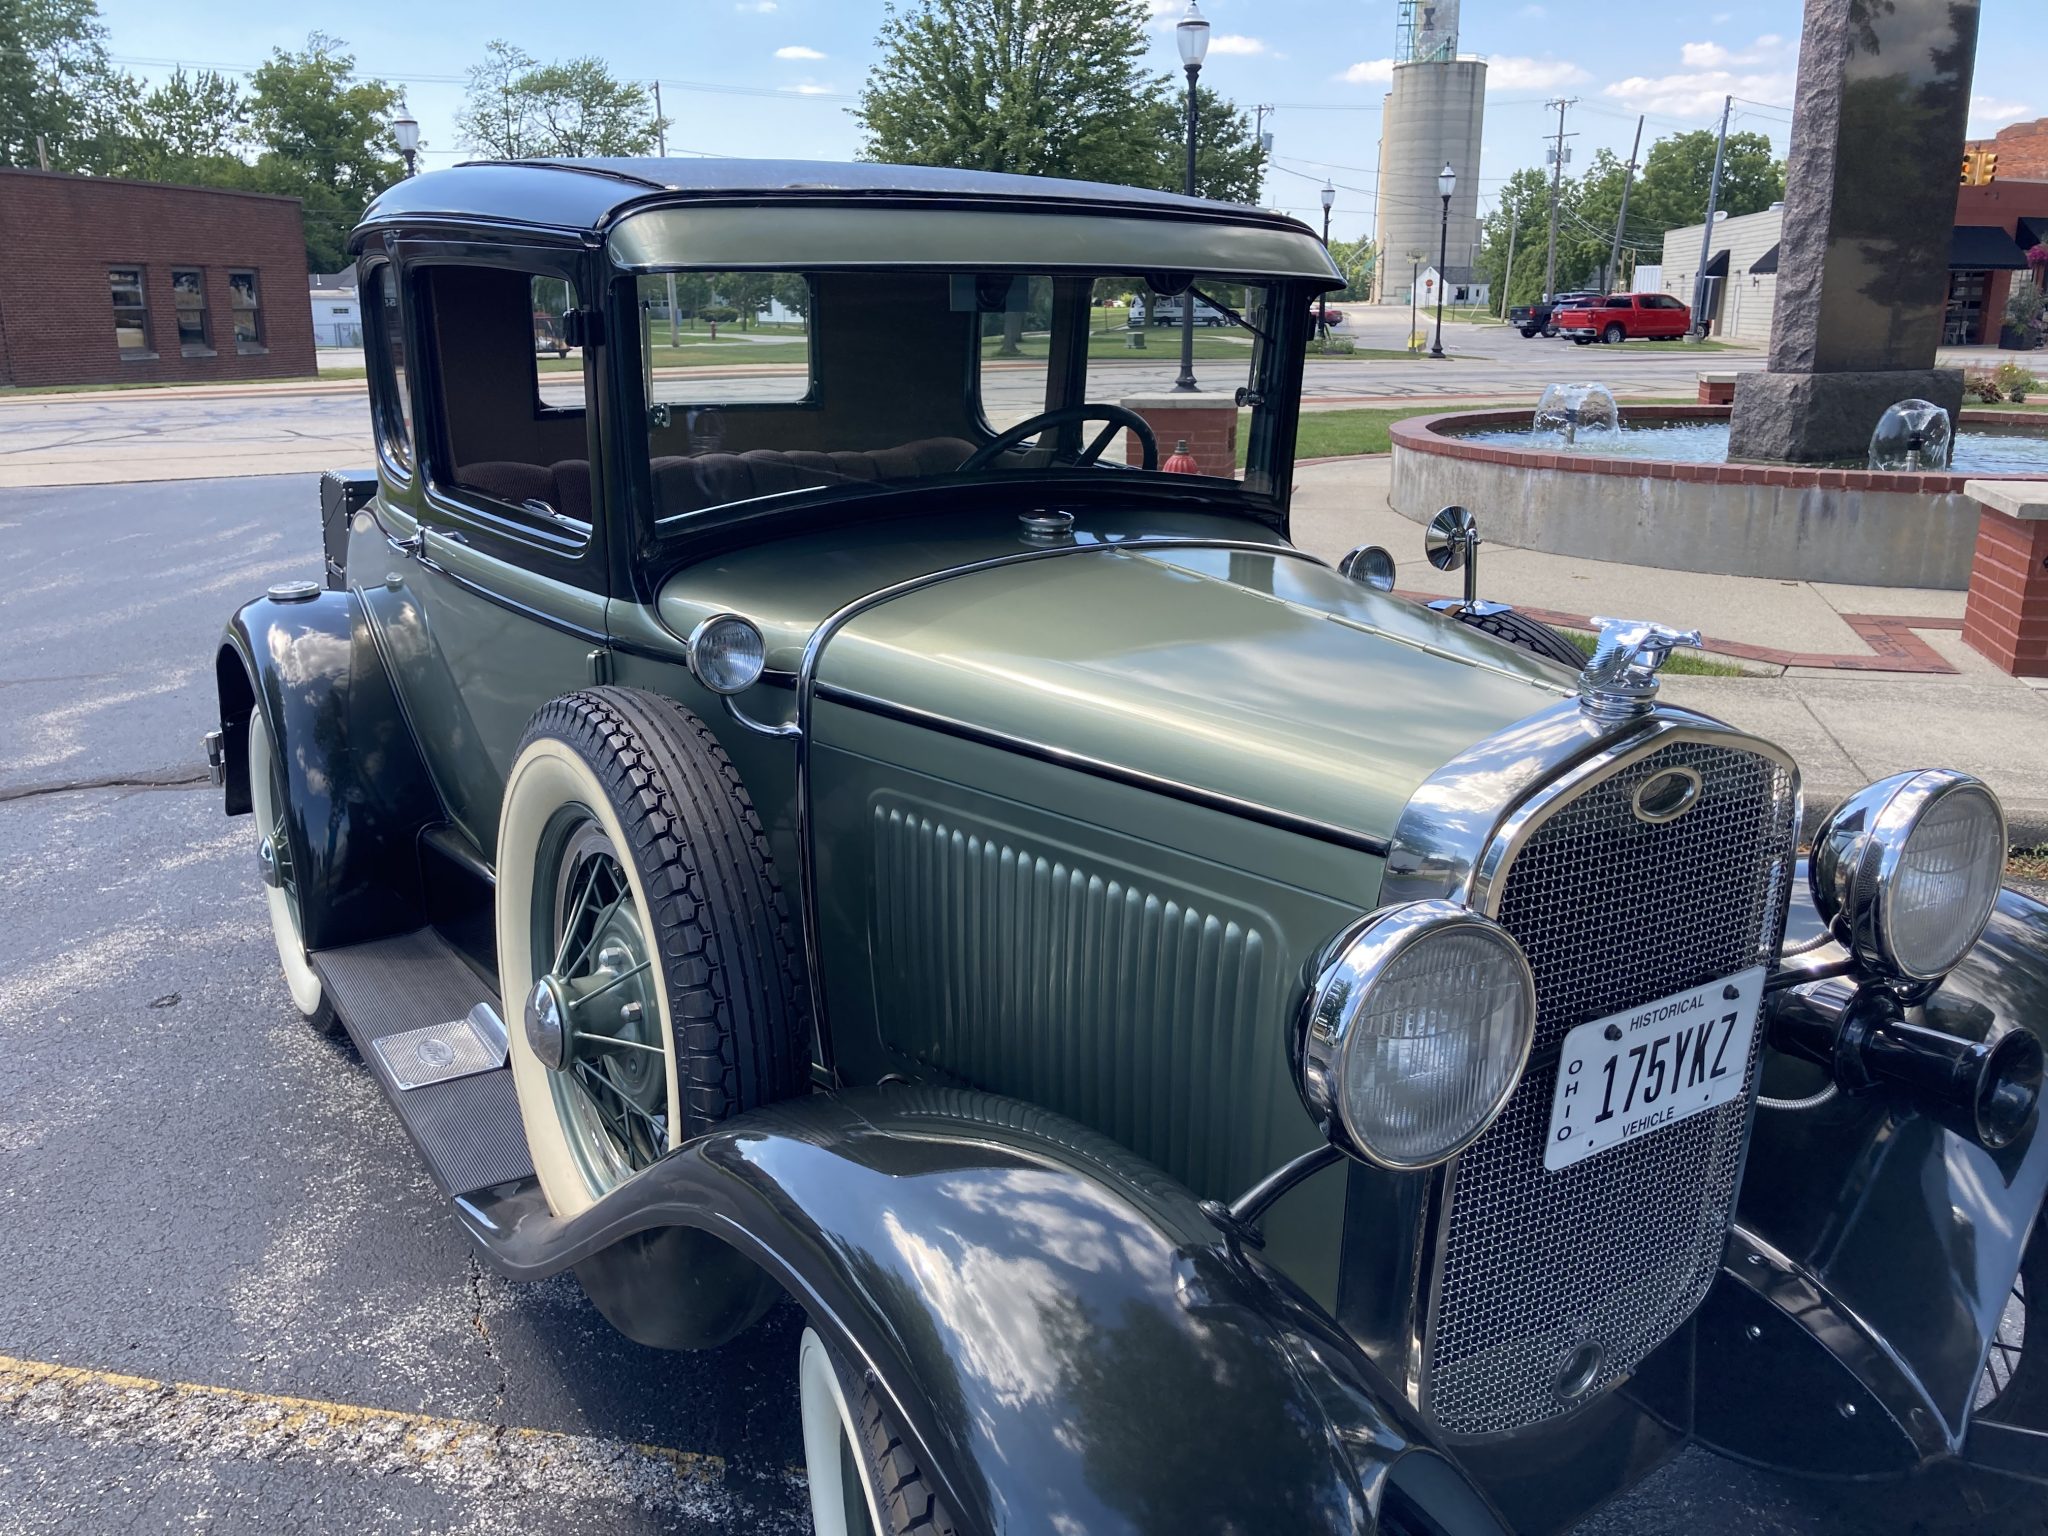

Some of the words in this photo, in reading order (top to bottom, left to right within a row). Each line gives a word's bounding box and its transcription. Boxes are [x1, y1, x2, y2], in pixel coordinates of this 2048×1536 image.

[1630, 995, 1704, 1031] HISTORICAL
[1594, 1011, 1738, 1124] 175YKZ
[1557, 1060, 1583, 1141] OHIO
[1622, 1106, 1675, 1138] VEHICLE
